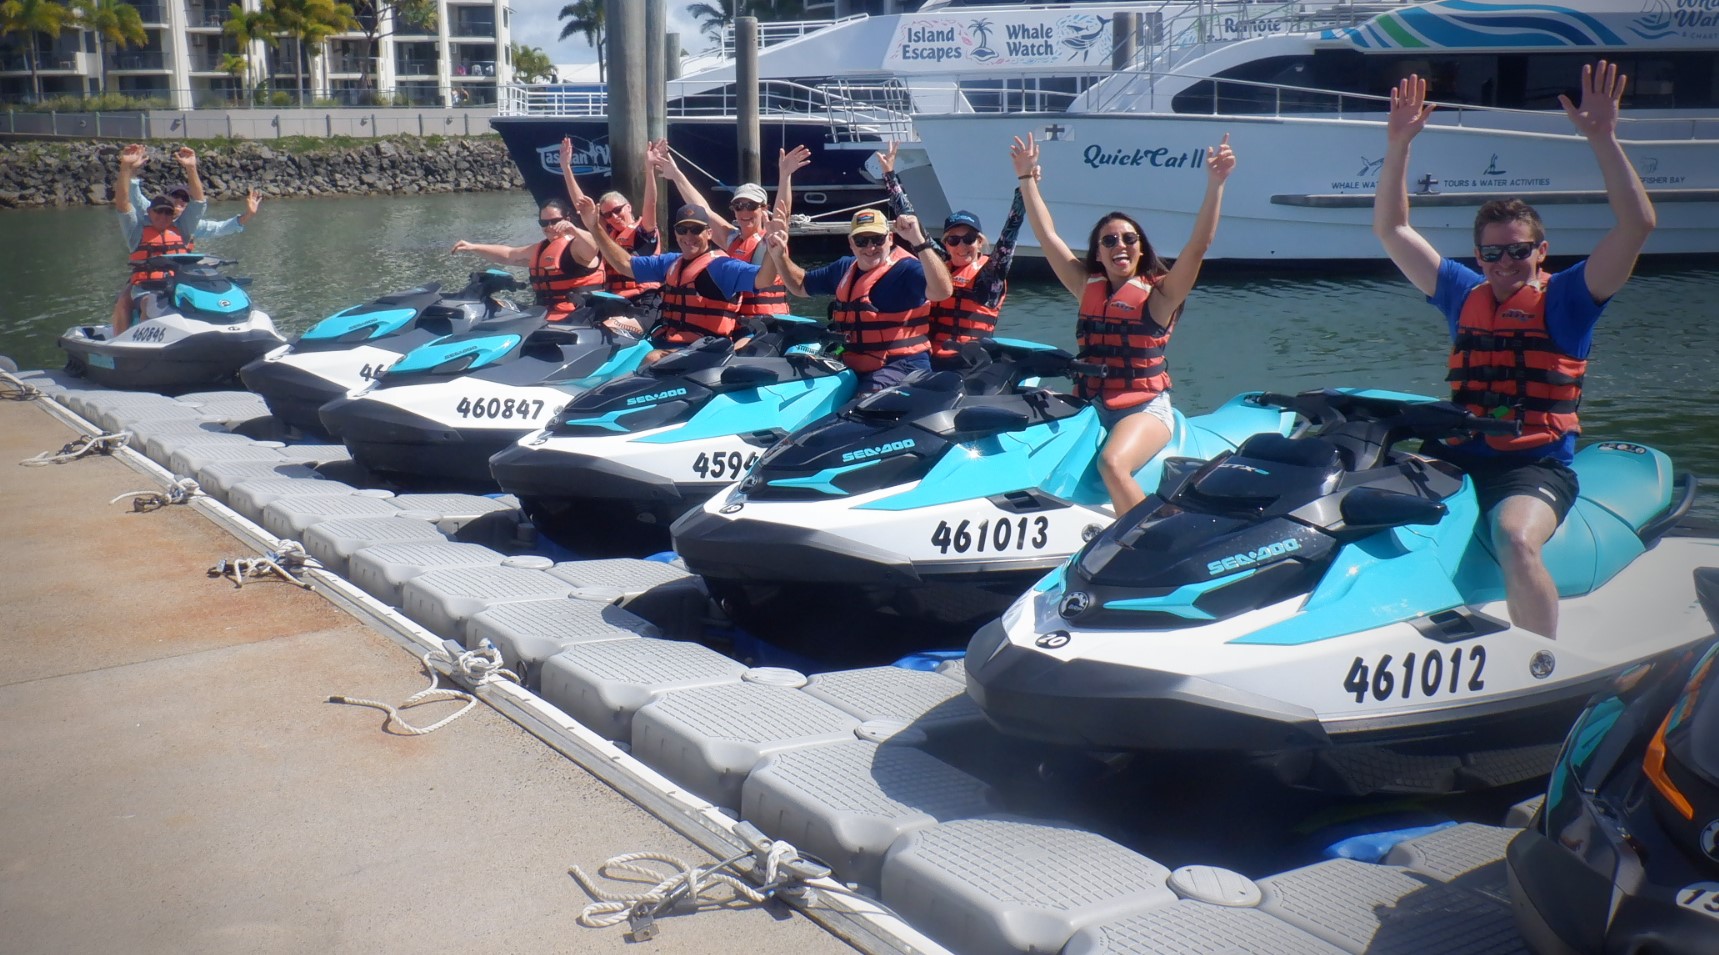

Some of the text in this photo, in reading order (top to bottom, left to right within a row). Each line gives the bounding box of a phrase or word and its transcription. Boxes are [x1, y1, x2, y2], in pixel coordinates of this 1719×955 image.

[907, 27, 955, 43] Island
[1005, 23, 1053, 40] Whale
[902, 45, 962, 62] Escapes
[1006, 40, 1054, 56] Watch
[1083, 144, 1144, 168] Quick
[1143, 147, 1188, 168] Cat
[1331, 181, 1360, 189] WHALE
[1444, 178, 1551, 187] TOURS & WATER ACTIVITIES
[1669, 176, 1686, 184] BAY
[456, 397, 545, 420] 460847
[931, 515, 1049, 554] 461013
[1038, 633, 1068, 647] 20
[1343, 645, 1487, 704] 461012
